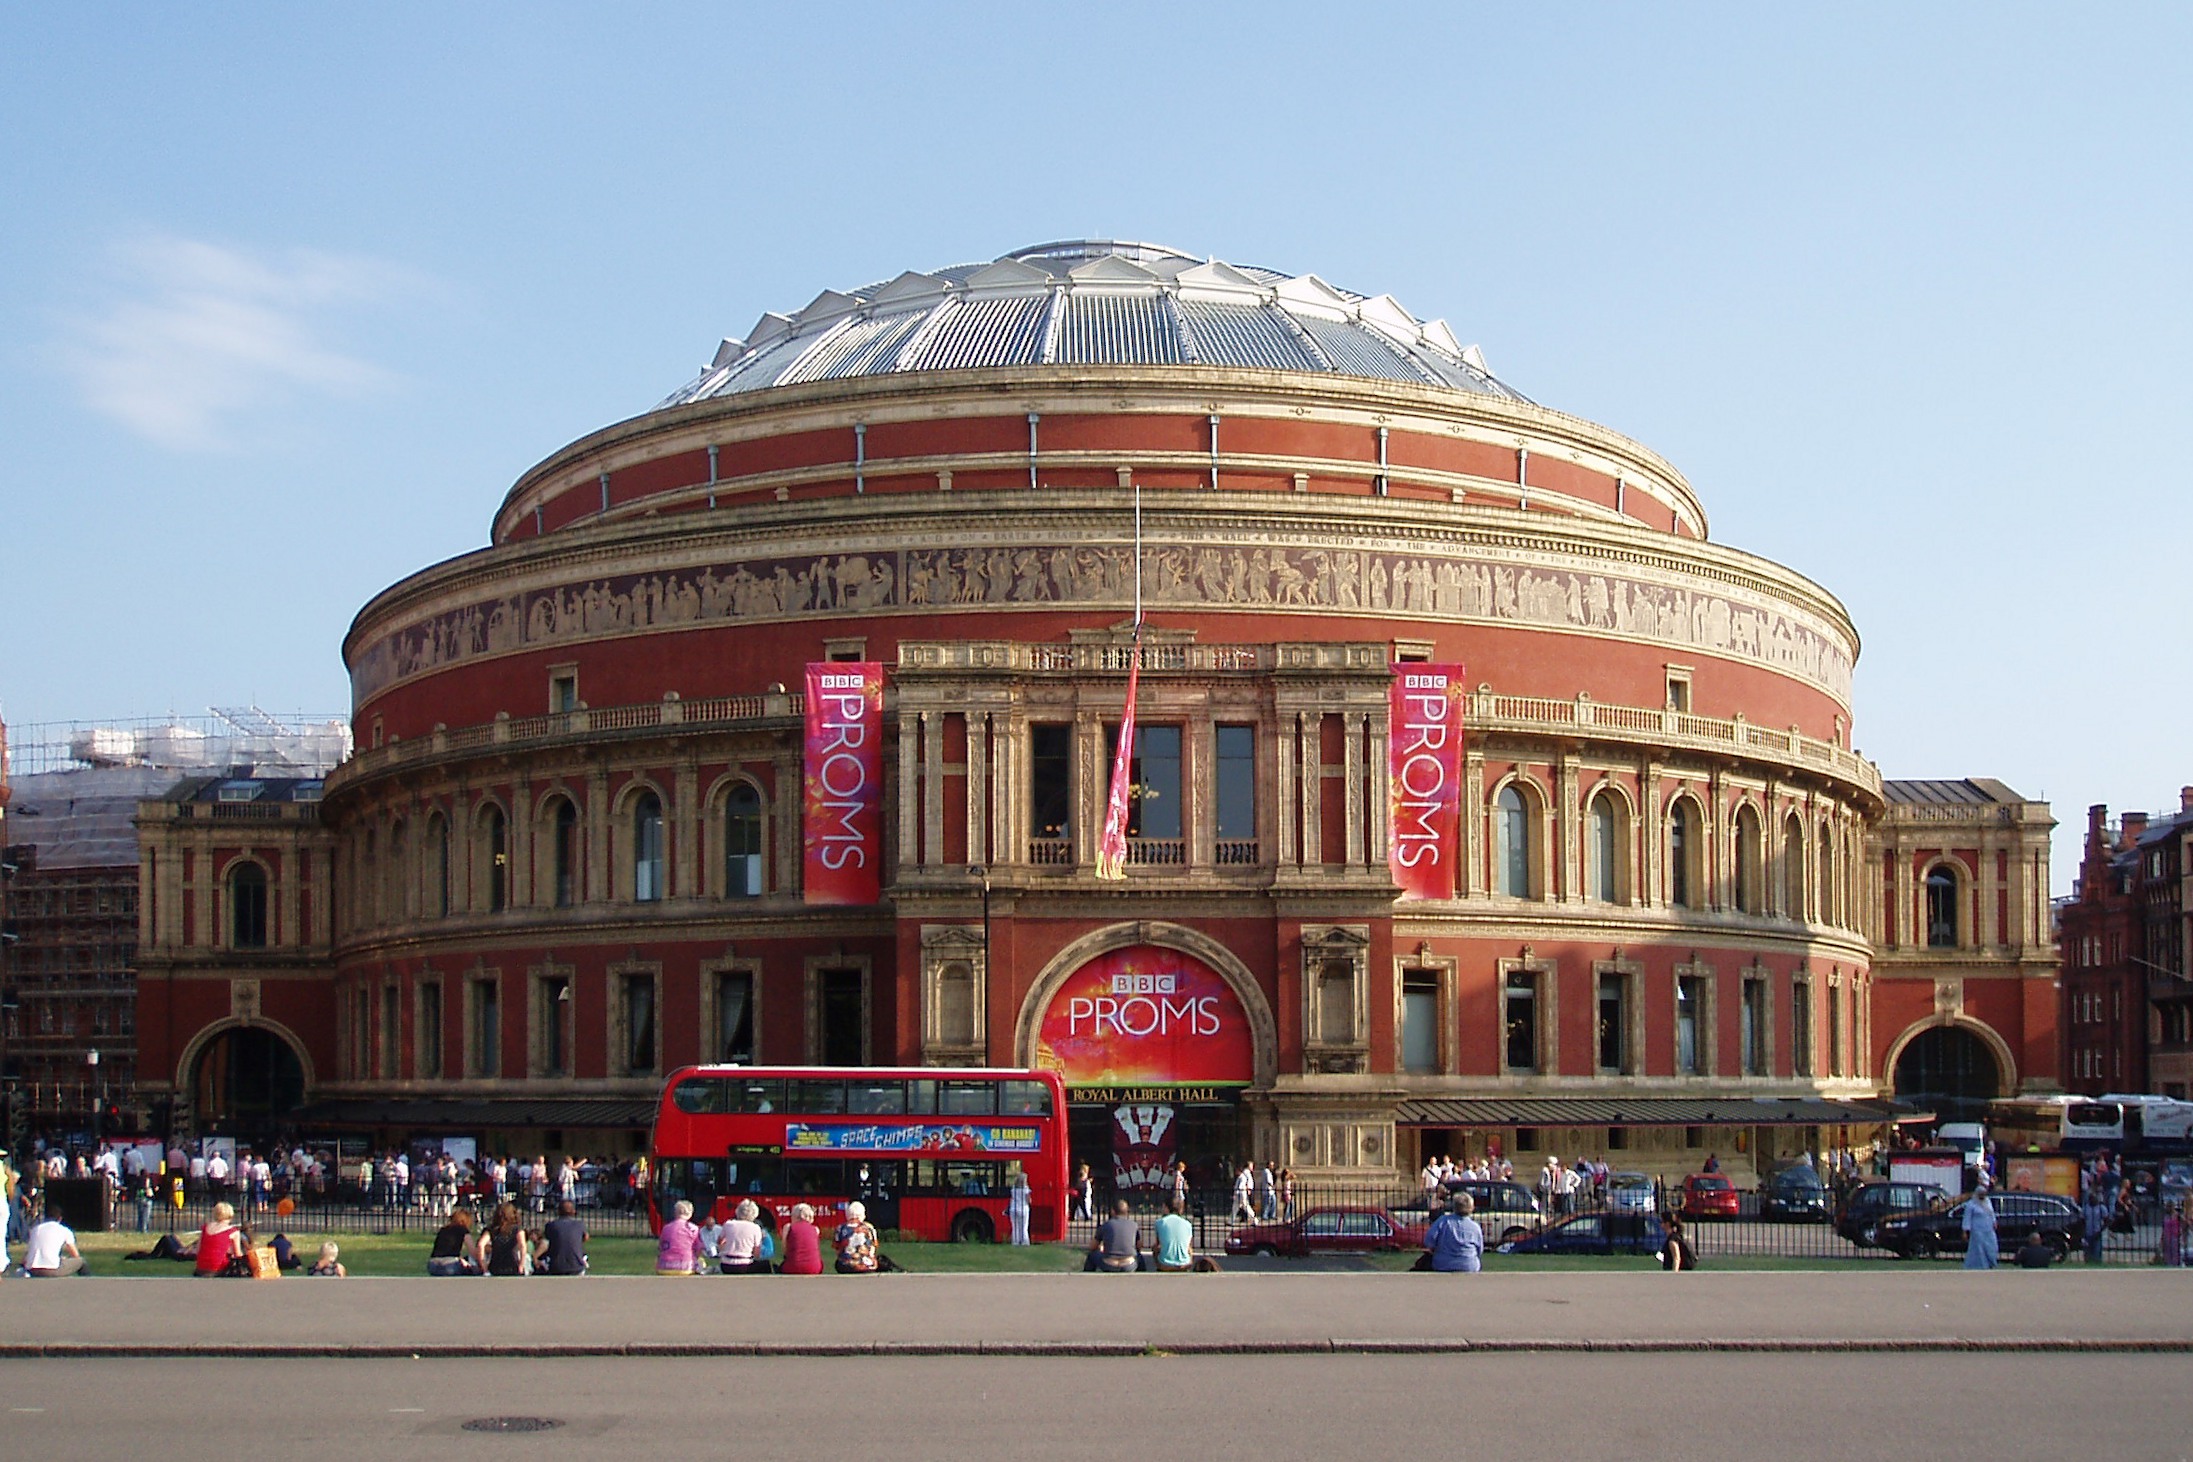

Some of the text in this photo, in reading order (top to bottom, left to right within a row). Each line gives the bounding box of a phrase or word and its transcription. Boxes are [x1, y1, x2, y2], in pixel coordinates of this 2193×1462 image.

[1307, 535, 1354, 546] ERECTED
[1370, 537, 1390, 548] FOR
[1407, 541, 1426, 551] THE
[1442, 542, 1511, 558] ADVANCEMENT
[1551, 555, 1566, 565] THE
[823, 676, 863, 687] BBC
[1407, 676, 1446, 687] BBC
[821, 694, 865, 869] PROMS
[1397, 694, 1447, 868] PROMS
[1115, 976, 1174, 992] BBC
[1070, 997, 1220, 1036] PROMS
[1073, 1087, 1219, 1101] ROYAL ALBERT HALL
[840, 1125, 878, 1149] SPACE
[874, 1124, 924, 1149] CHIMPS
